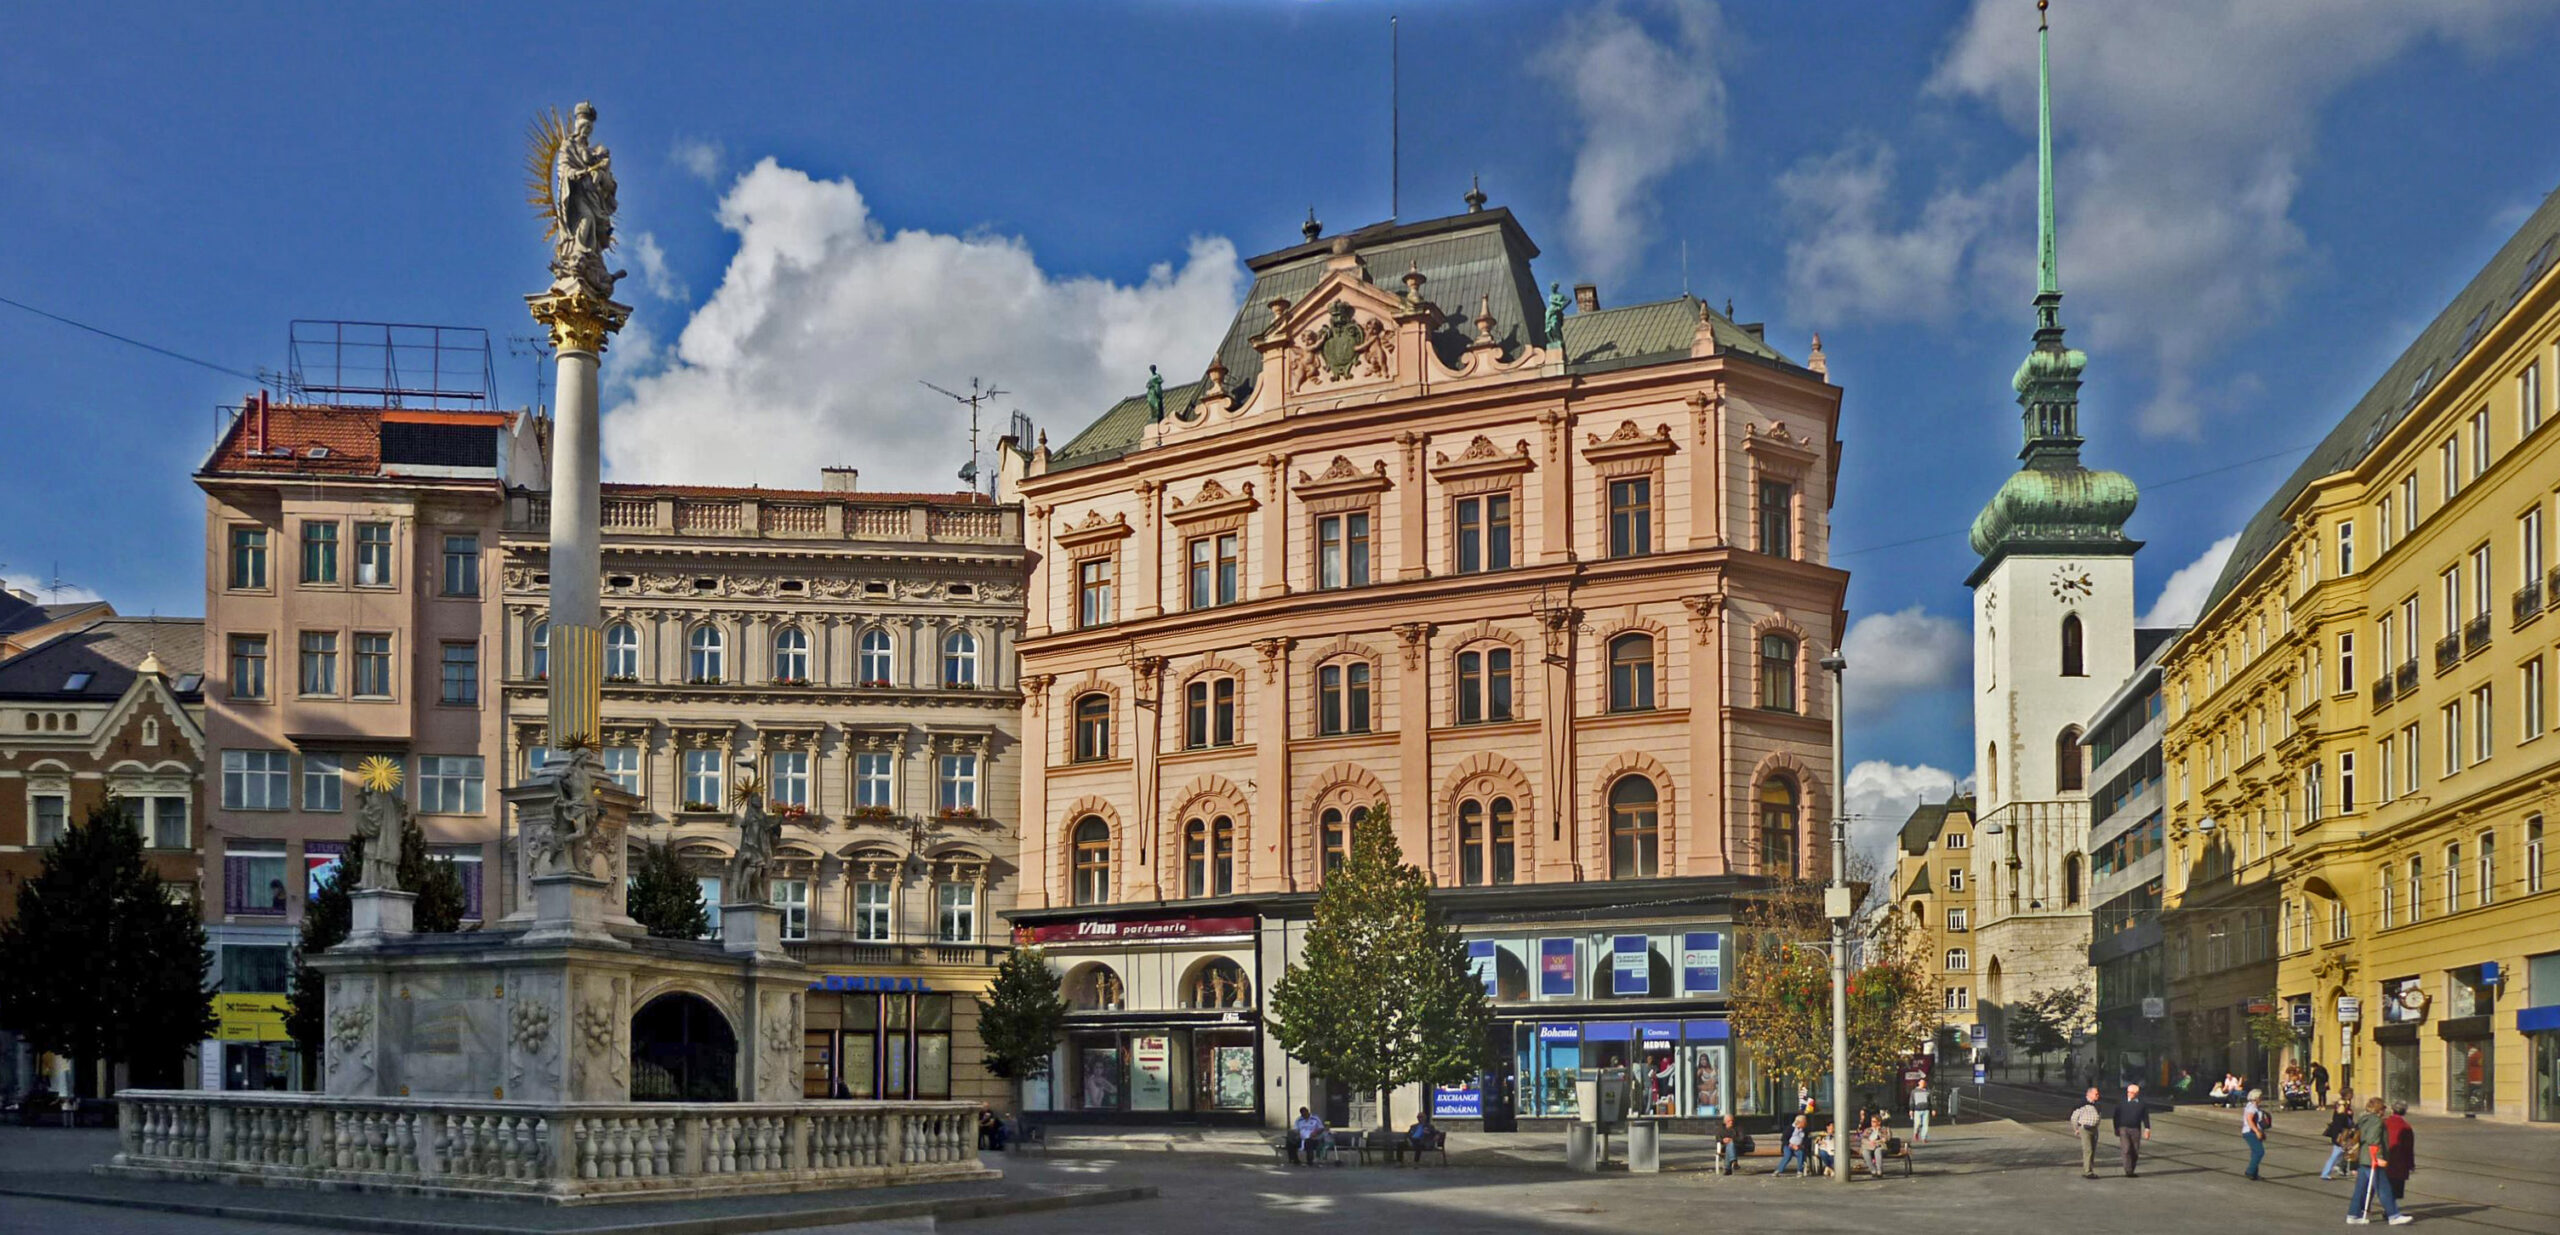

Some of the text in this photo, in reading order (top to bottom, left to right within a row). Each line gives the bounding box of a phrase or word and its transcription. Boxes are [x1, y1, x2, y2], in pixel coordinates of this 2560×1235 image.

[1122, 923, 1187, 936] parfumerie
[1540, 1026, 1578, 1038] Bohemia
[1643, 1040, 1671, 1049] HEDVA
[1437, 1093, 1480, 1102] EXCHANGE
[1435, 1104, 1478, 1114] SMĚNÁRNA
